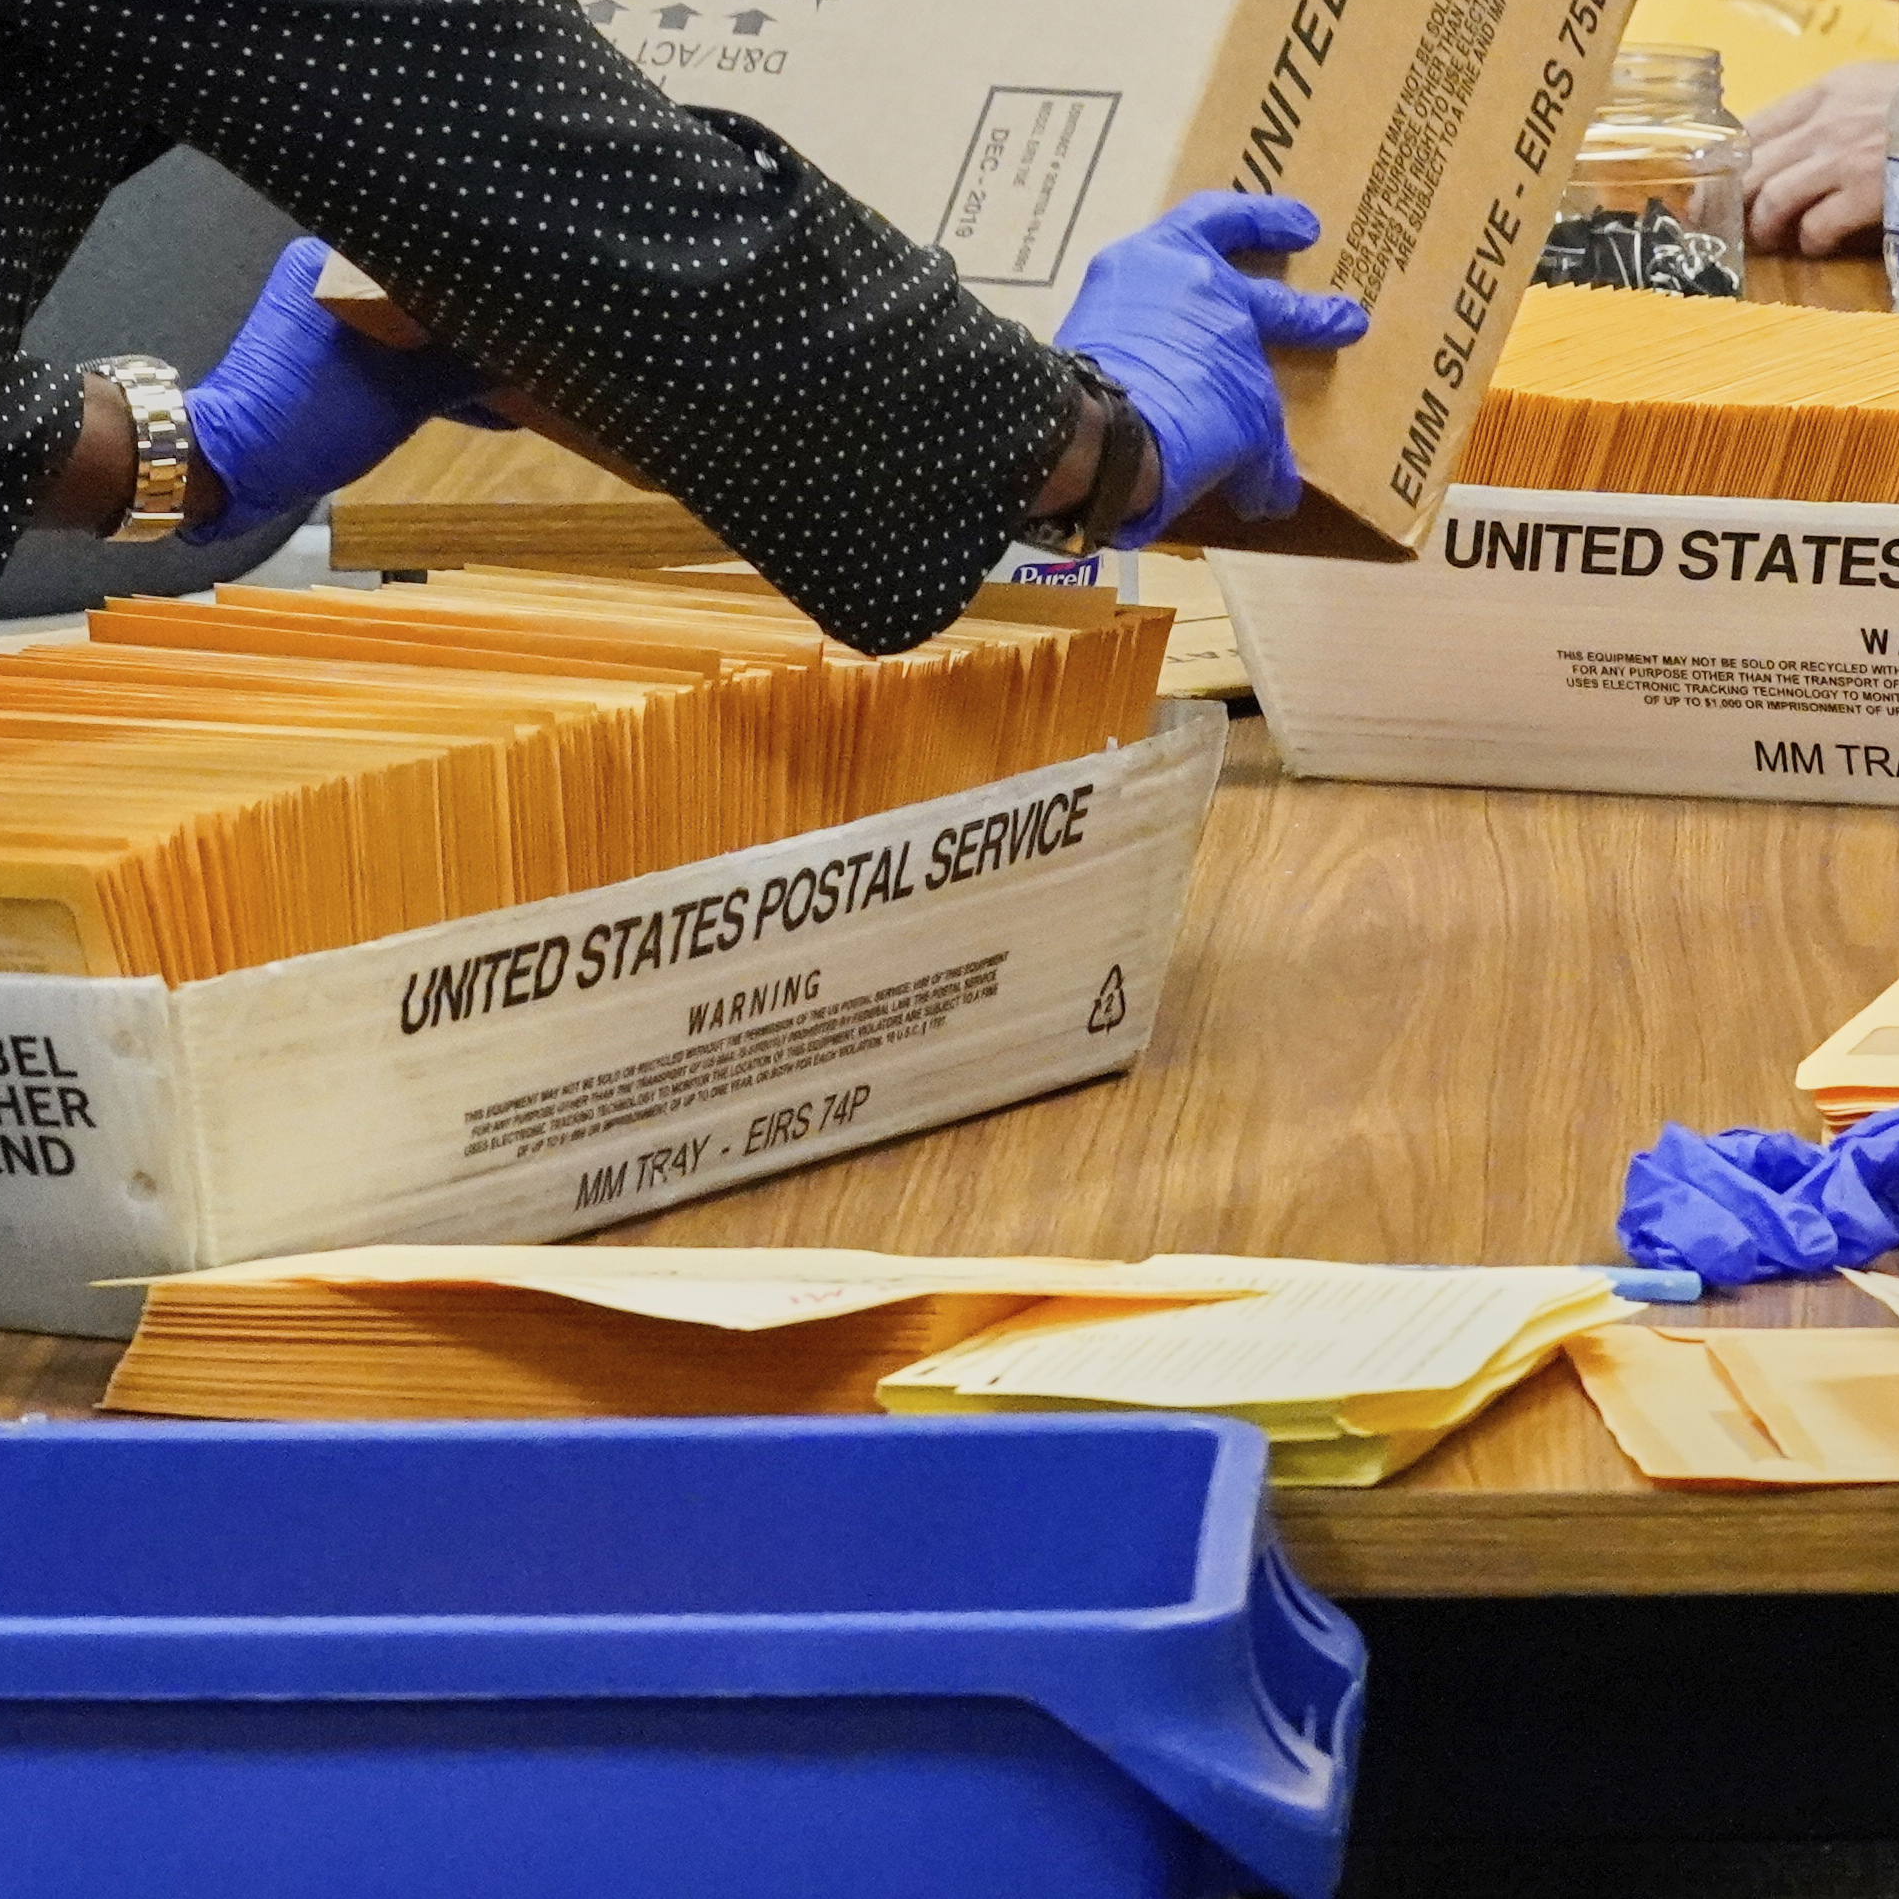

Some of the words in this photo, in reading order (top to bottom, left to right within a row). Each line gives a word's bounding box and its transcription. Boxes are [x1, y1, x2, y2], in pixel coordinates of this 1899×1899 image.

[1351, 245, 1373, 287] FOR
[1367, 203, 1388, 247] ANY
[1380, 119, 1421, 206] PURPOSE
[1414, 55, 1445, 118] OTHER
[1437, 4, 1464, 54] THAN
[1395, 178, 1417, 217] THE
[1409, 123, 1438, 181] RIGHT
[1441, 59, 1464, 96] USE
[1329, 250, 1354, 291] THIS
[1346, 143, 1392, 251] EQUIPMENT
[1385, 103, 1406, 146] MAY
[1400, 63, 1422, 105] NOT
[1390, 388, 1449, 508] EMM
[1433, 199, 1520, 389] SLEEVE
[1515, 59, 1573, 174] EIRS
[1019, 563, 1093, 587] Purell
[1445, 518, 1663, 576] UNITED
[1556, 649, 1583, 661] THIS
[1586, 651, 1657, 664] EQUIPMENT
[1661, 655, 1687, 665] MAY
[1691, 656, 1716, 667] NOT
[1720, 657, 1735, 668] BE
[1740, 658, 1775, 670] SOLD
[1777, 659, 1797, 671] OR
[1800, 660, 1868, 674] RECYCLED
[1565, 677, 1599, 688] USES
[1602, 678, 1680, 692] ELECTRONIC
[1684, 682, 1748, 695] TRACKING
[1752, 685, 1838, 699] TECHNOLOGY
[1842, 689, 1859, 701] TO
[1571, 664, 1597, 675] FOR
[1600, 665, 1624, 676] ANY
[1628, 666, 1687, 679] PURPOSE
[1691, 669, 1734, 681] OTHER
[1738, 671, 1772, 683] THAN
[1775, 673, 1799, 685] THE
[1804, 674, 1878, 687] TRANSPORT
[1882, 678, 1899, 689] OF
[1643, 694, 1659, 705] OF
[1663, 695, 1680, 705] UP
[1685, 696, 1701, 707] TO
[1744, 699, 1763, 709] OR
[1766, 700, 1861, 713] IMPRISONMENT
[1864, 704, 1881, 715] OF
[1754, 740, 1824, 774] MM
[401, 935, 569, 1034] UNITED
[576, 888, 749, 988] STATES
[753, 841, 913, 938] POSTAL
[925, 784, 1093, 889] SERVICE
[688, 969, 820, 1035] WARNING
[577, 1160, 628, 1212] MM
[637, 1133, 712, 1193] TRAY
[745, 1101, 813, 1153] EIRS
[818, 1083, 872, 1132] 74P
